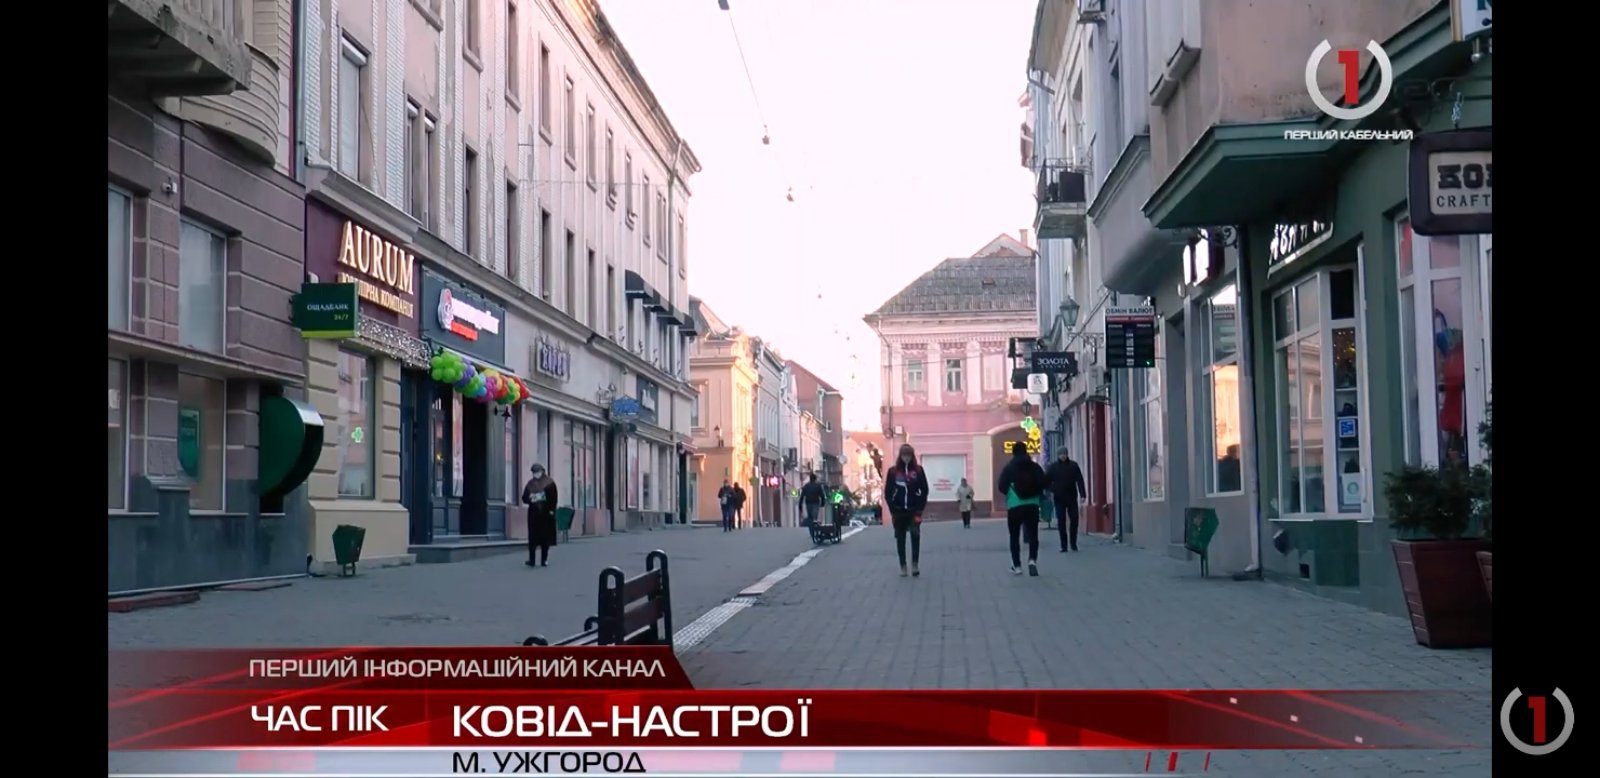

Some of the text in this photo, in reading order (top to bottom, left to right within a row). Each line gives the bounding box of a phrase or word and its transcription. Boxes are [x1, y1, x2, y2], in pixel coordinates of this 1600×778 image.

[1436, 195, 1491, 208] CRAFT
[339, 220, 414, 295] AURUM
[306, 303, 349, 311] ОЩАДБАНК
[1128, 307, 1153, 315] ВАЛЮТ
[1037, 357, 1070, 365] ЗОЛОТА
